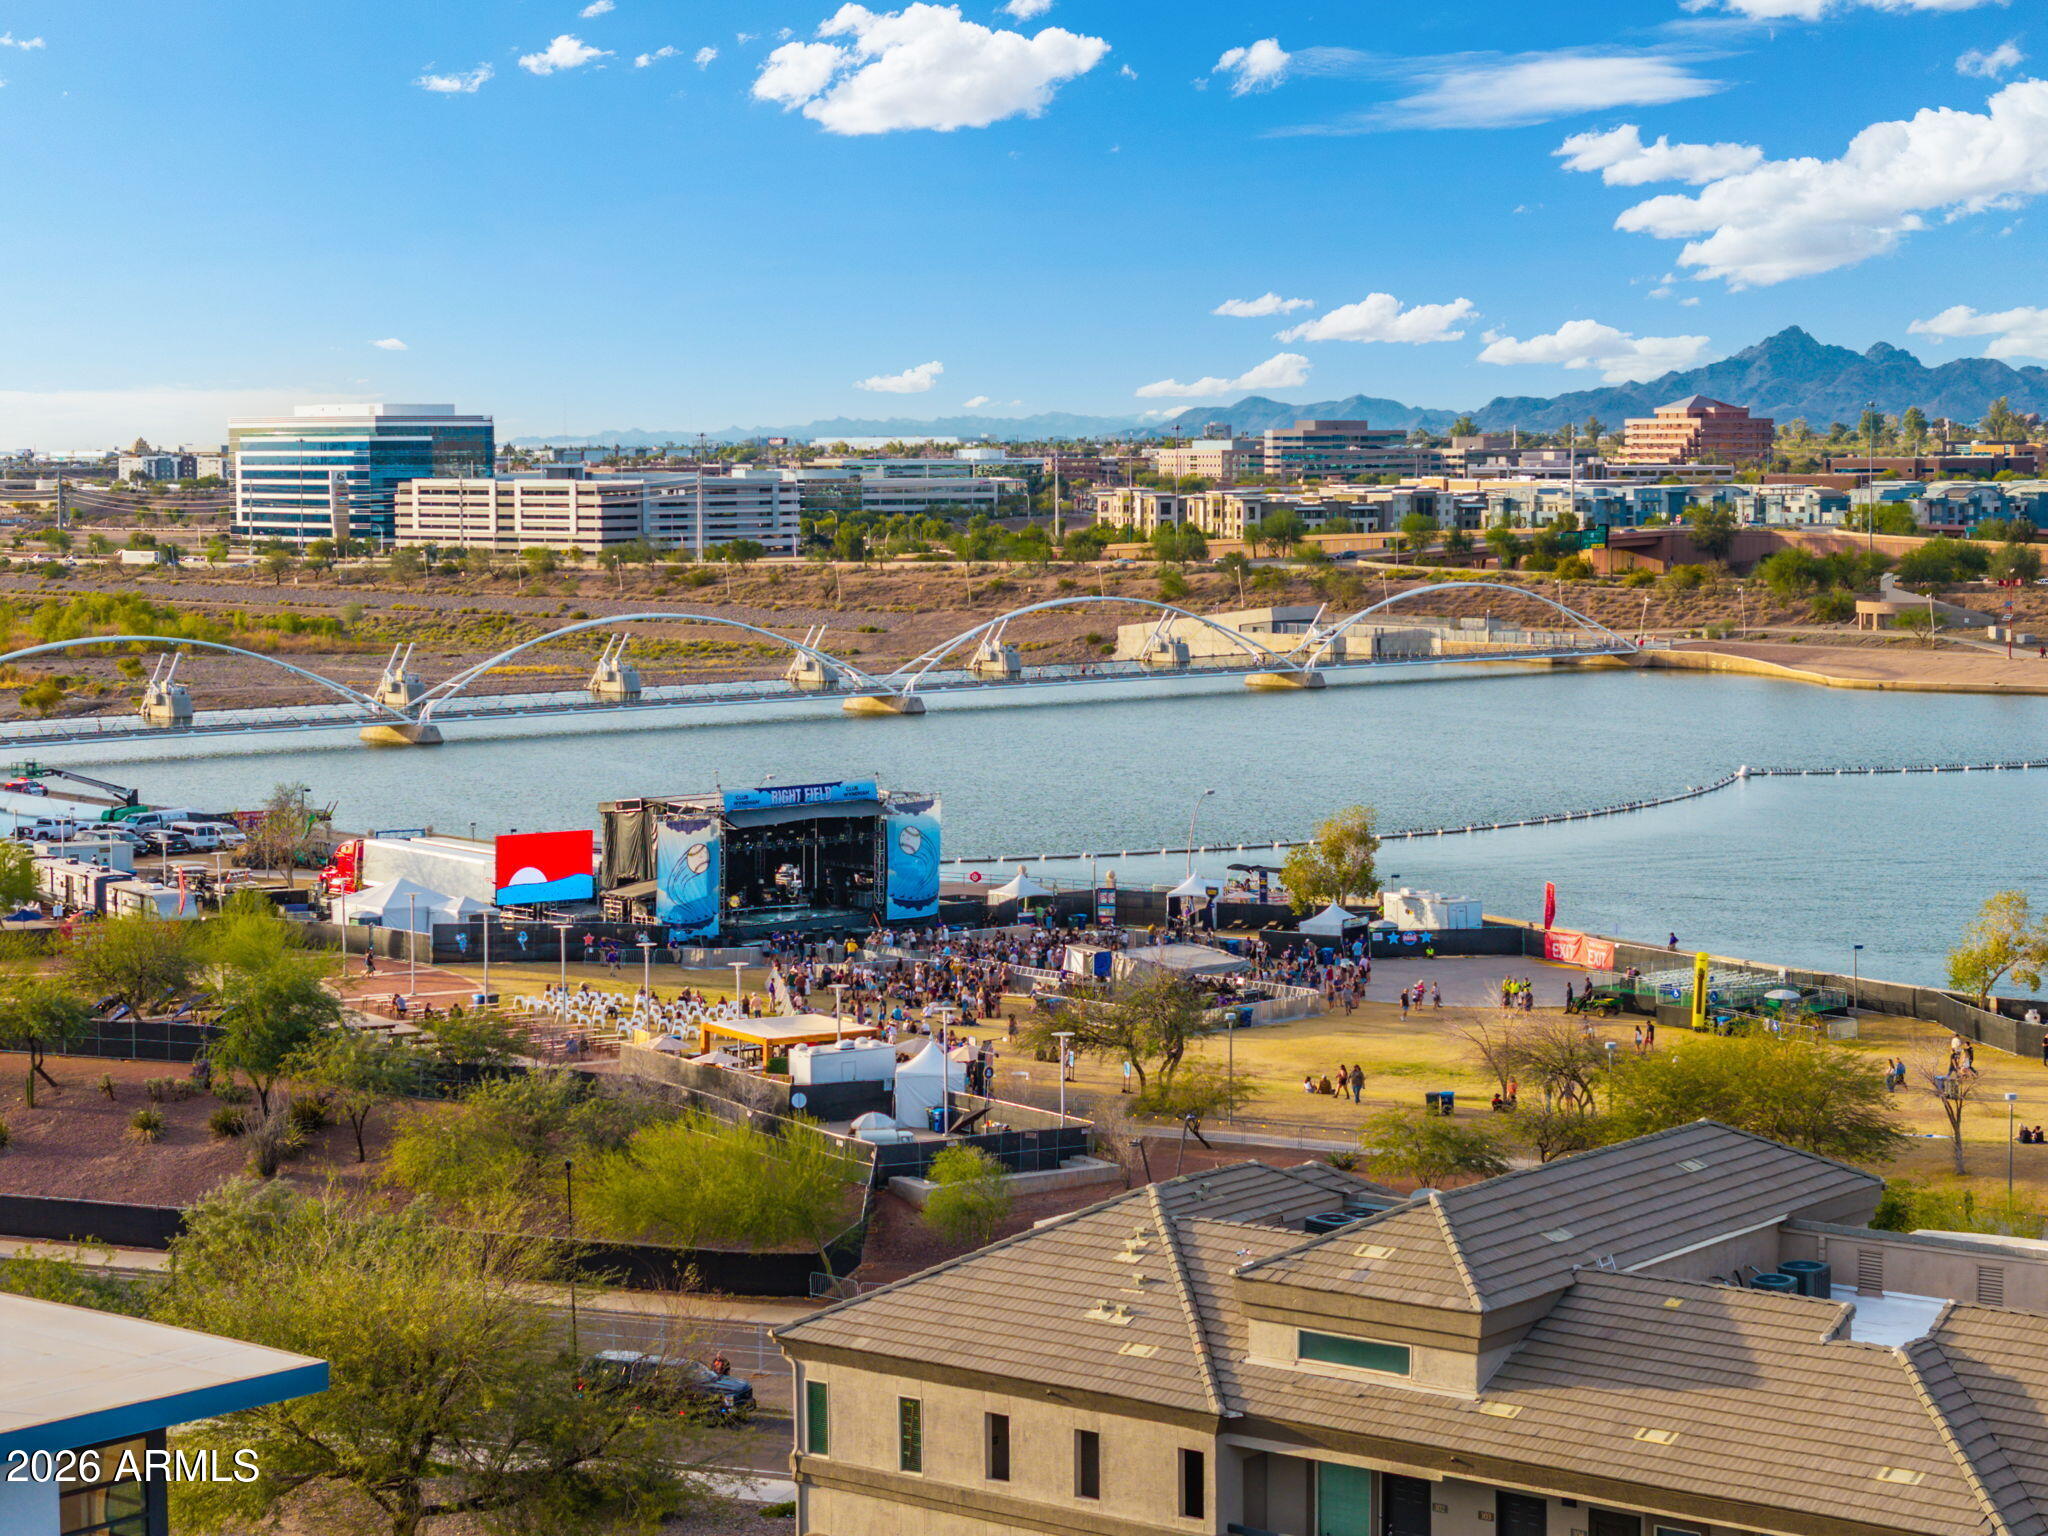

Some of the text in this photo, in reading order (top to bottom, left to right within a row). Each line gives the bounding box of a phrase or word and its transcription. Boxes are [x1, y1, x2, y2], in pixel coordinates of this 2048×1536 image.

[771, 786, 832, 804] RIGHT FIELD
[1552, 943, 1575, 959] EXIT
[1587, 950, 1607, 967] EXIT
